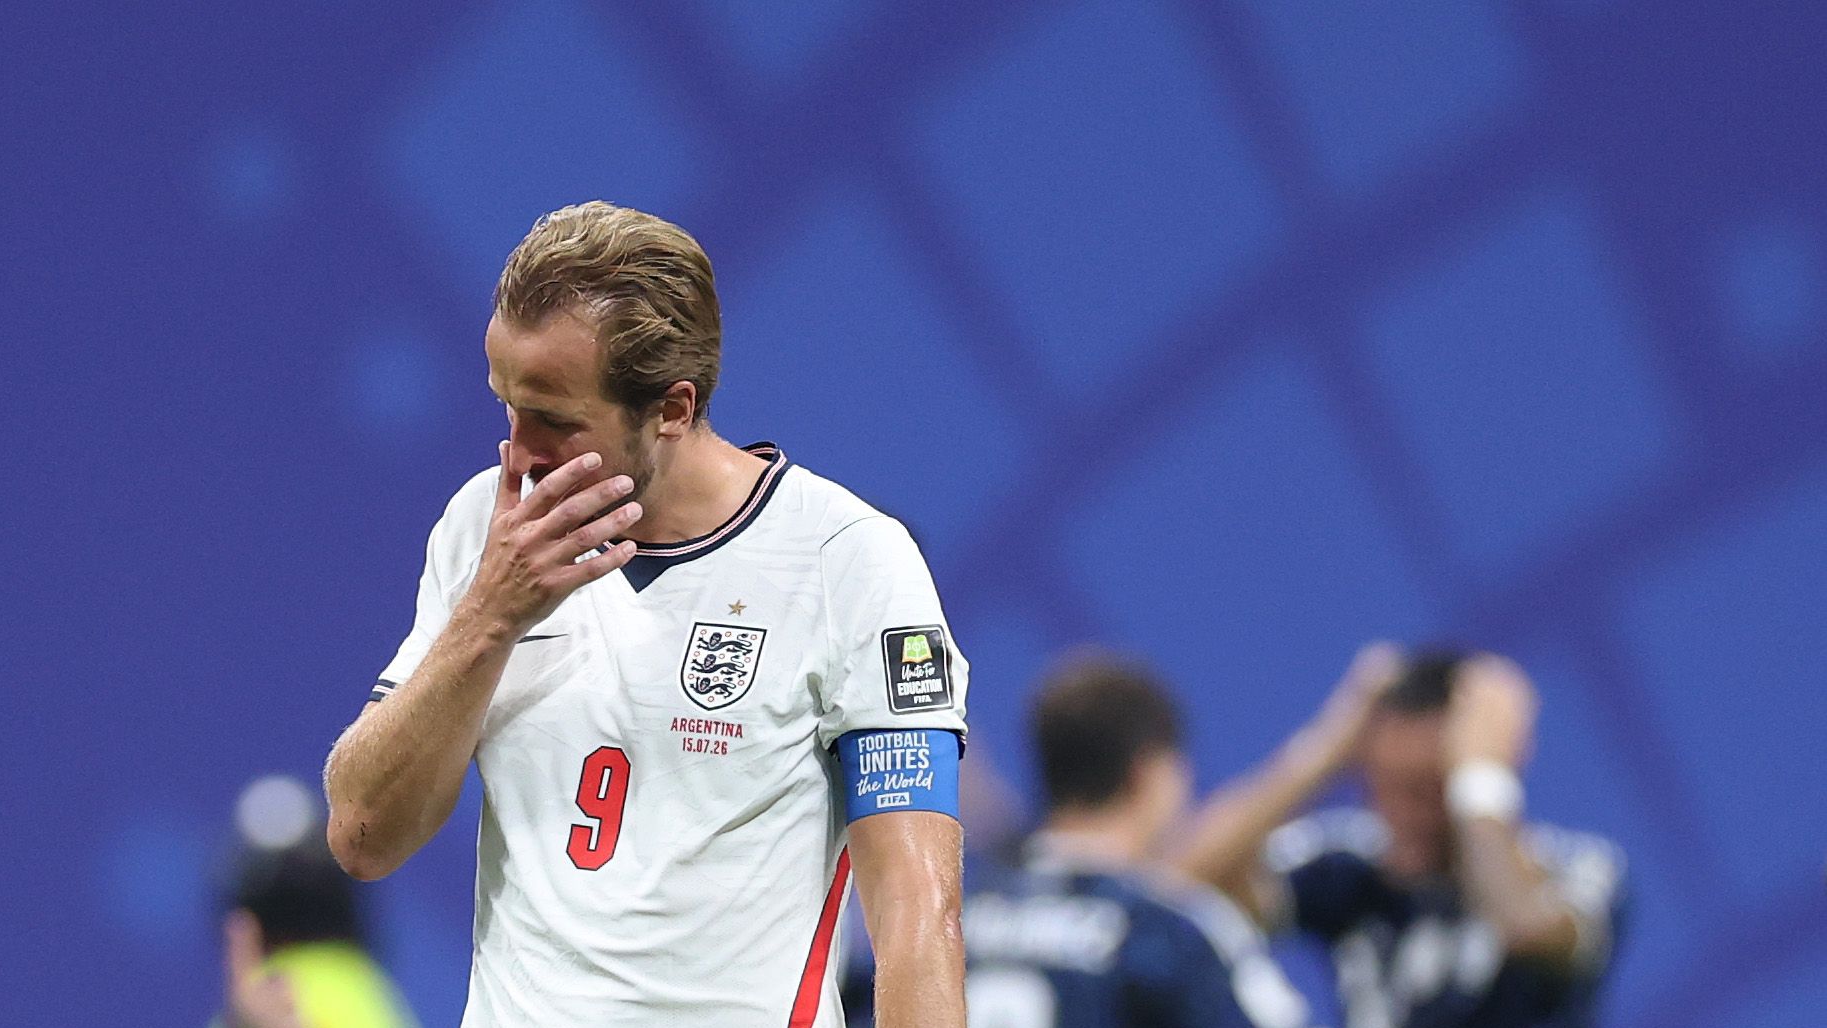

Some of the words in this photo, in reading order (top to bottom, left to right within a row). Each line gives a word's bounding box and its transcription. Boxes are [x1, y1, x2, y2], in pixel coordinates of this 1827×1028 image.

[897, 678, 943, 696] EDUCATION
[670, 717, 743, 739] ARGENTINA
[682, 737, 728, 755] 15.07.26
[857, 732, 929, 753] FOOTBALL
[859, 748, 930, 775] UNITES
[856, 775, 882, 796] the
[884, 769, 934, 791] World
[566, 745, 631, 871] 9
[879, 794, 908, 806] FIFA
